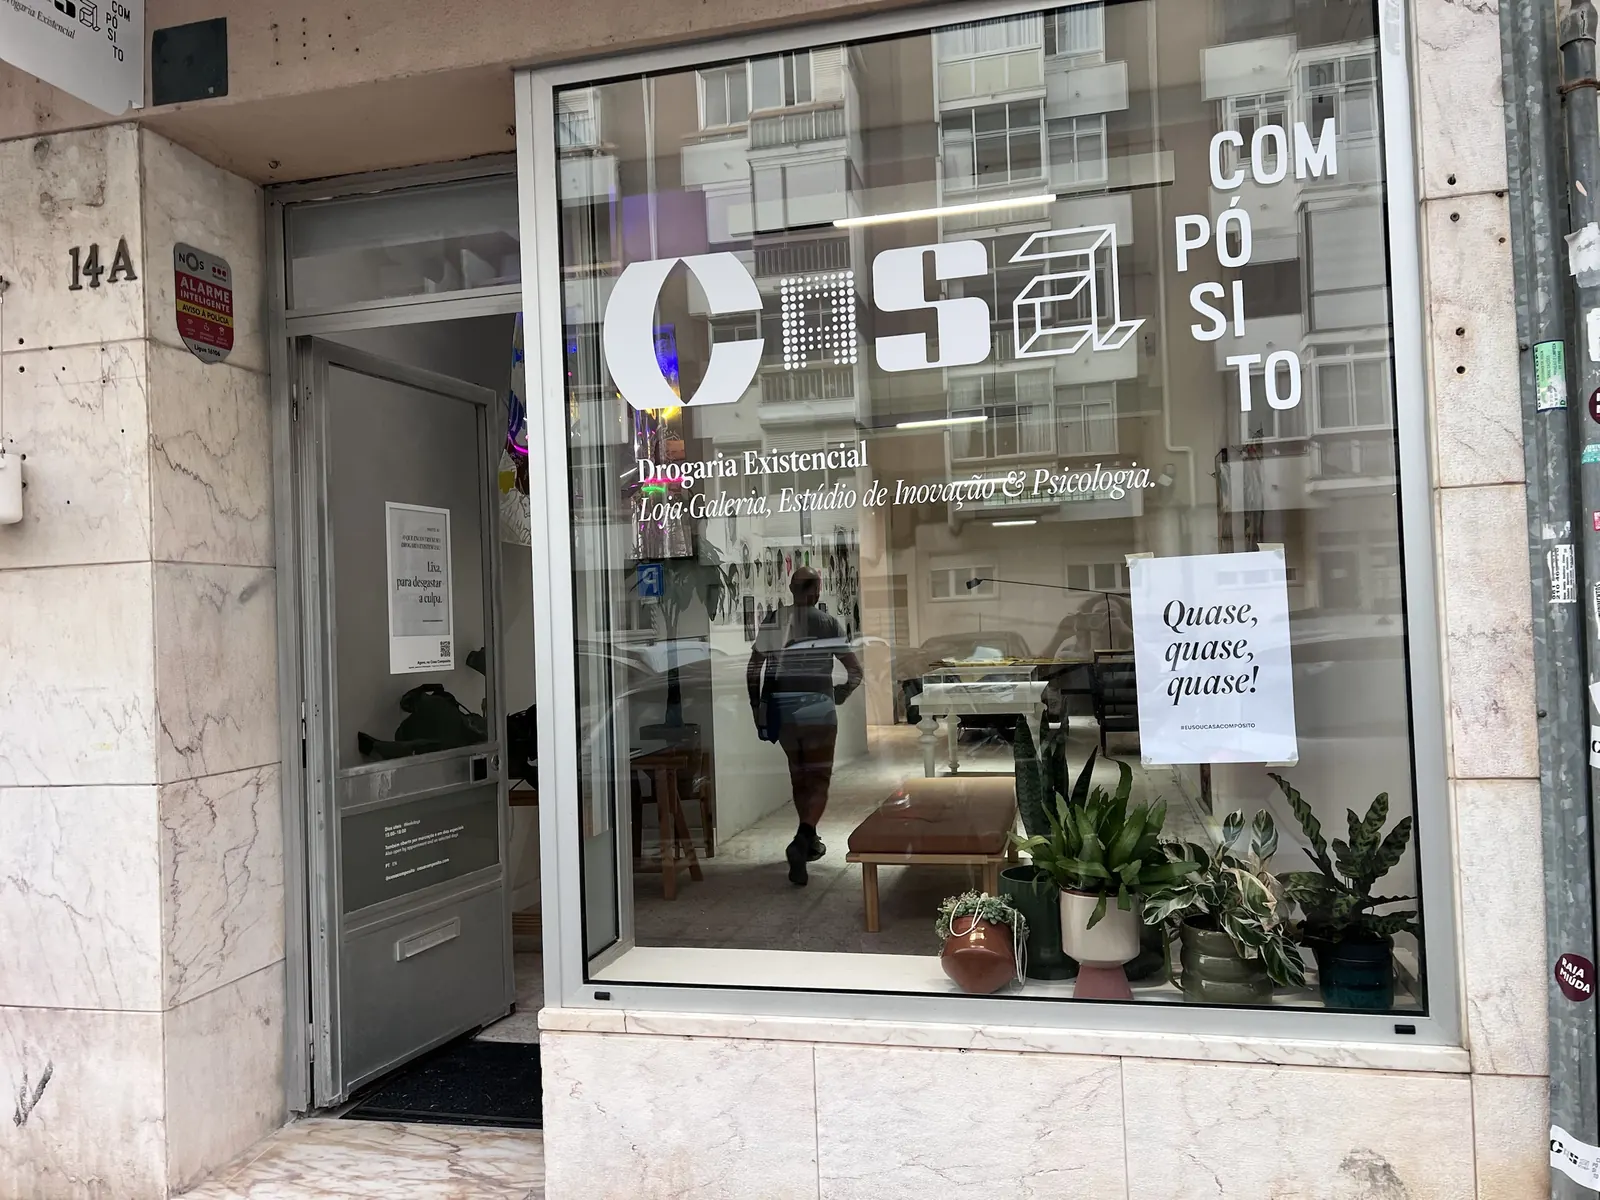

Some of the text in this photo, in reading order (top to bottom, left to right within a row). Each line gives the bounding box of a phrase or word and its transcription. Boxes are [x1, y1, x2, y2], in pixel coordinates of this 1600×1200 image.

[37, 10, 76, 39] Existencial
[106, 12, 118, 29] PÓ
[112, 0, 131, 22] COM
[107, 28, 117, 43] SI
[112, 45, 124, 62] TO
[1209, 117, 1338, 190] COM
[1175, 196, 1252, 272] PÓ
[68, 234, 138, 291] 14A
[178, 252, 205, 271] NOS
[180, 276, 230, 304] ALARME
[180, 289, 230, 313] INTELIGENTE
[182, 304, 200, 316] AVISO
[1189, 280, 1246, 341] SI
[1226, 350, 1301, 412] TO
[637, 440, 868, 489] Drogaria Existencial
[778, 483, 857, 514] Estúdio
[862, 480, 888, 508] de
[893, 473, 996, 511] Inovação
[1002, 470, 1027, 498] &
[1031, 461, 1156, 500] Psicologia.
[427, 561, 442, 574] Lixa,
[396, 575, 443, 591] para desgastar
[418, 591, 443, 607] a culpa.
[1163, 599, 1258, 634] Quase,
[1164, 638, 1254, 672] quase,
[1167, 665, 1260, 706] quase!
[1560, 967, 1591, 994] MIÚDA
[1562, 957, 1585, 979] RAIA
